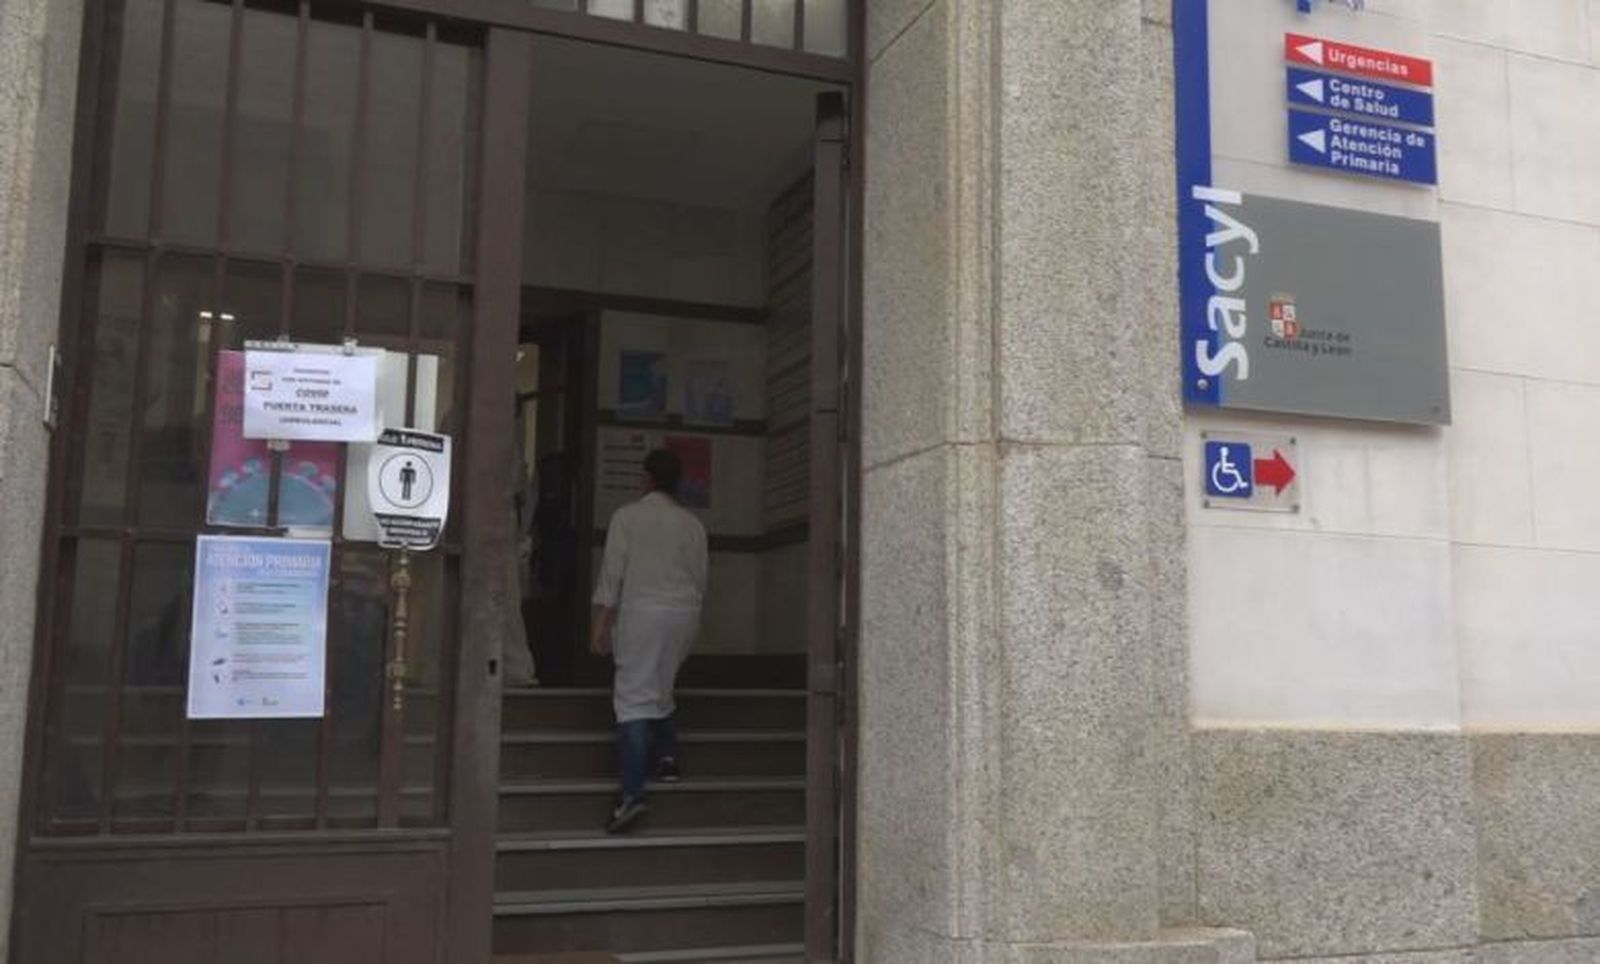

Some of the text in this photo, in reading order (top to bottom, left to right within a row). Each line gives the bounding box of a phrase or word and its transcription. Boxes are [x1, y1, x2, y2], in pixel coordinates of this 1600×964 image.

[1328, 48, 1409, 76] Urgencias
[1329, 78, 1385, 100] Centro
[1330, 94, 1399, 118] de Salud
[1329, 118, 1426, 147] Gerencia de
[1330, 135, 1402, 159] Atención
[1331, 151, 1400, 175] Primaria
[1192, 185, 1259, 381] Sacyl
